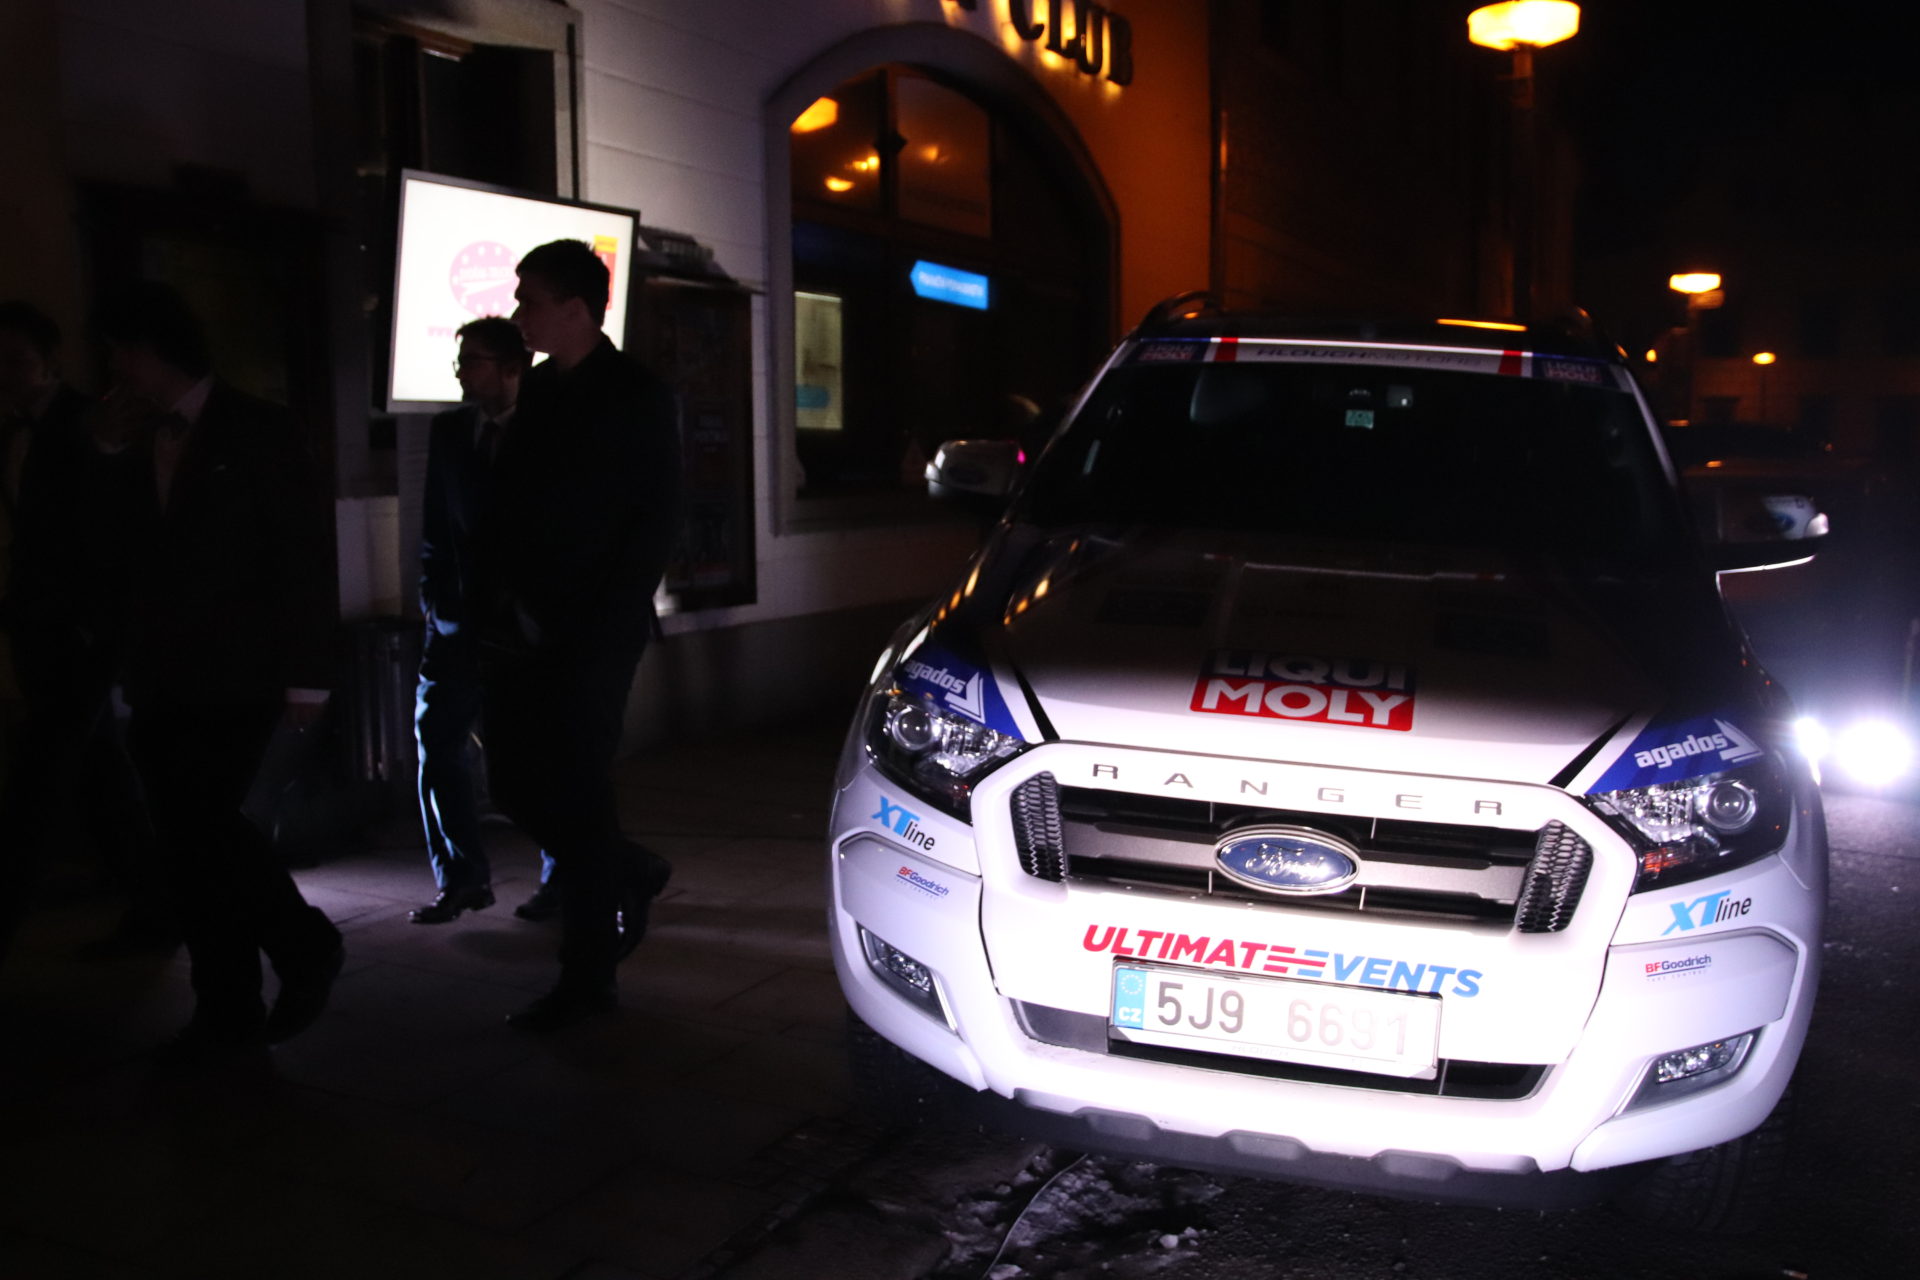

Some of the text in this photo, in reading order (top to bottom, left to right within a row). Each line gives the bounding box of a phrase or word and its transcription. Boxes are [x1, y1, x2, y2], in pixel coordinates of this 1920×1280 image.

[904, 659, 968, 694] agados
[1213, 650, 1407, 690] LIQUI
[1201, 679, 1412, 726] MOLY
[1634, 733, 1729, 769] agados
[1092, 763, 1503, 816] RANGER
[1245, 842, 1327, 879] Ford
[898, 866, 950, 896] BFGoodrich
[1645, 954, 1713, 974] BFGoodrich
[1118, 1006, 1142, 1023] CZ
[1156, 980, 1409, 1056] 5J9 6691
